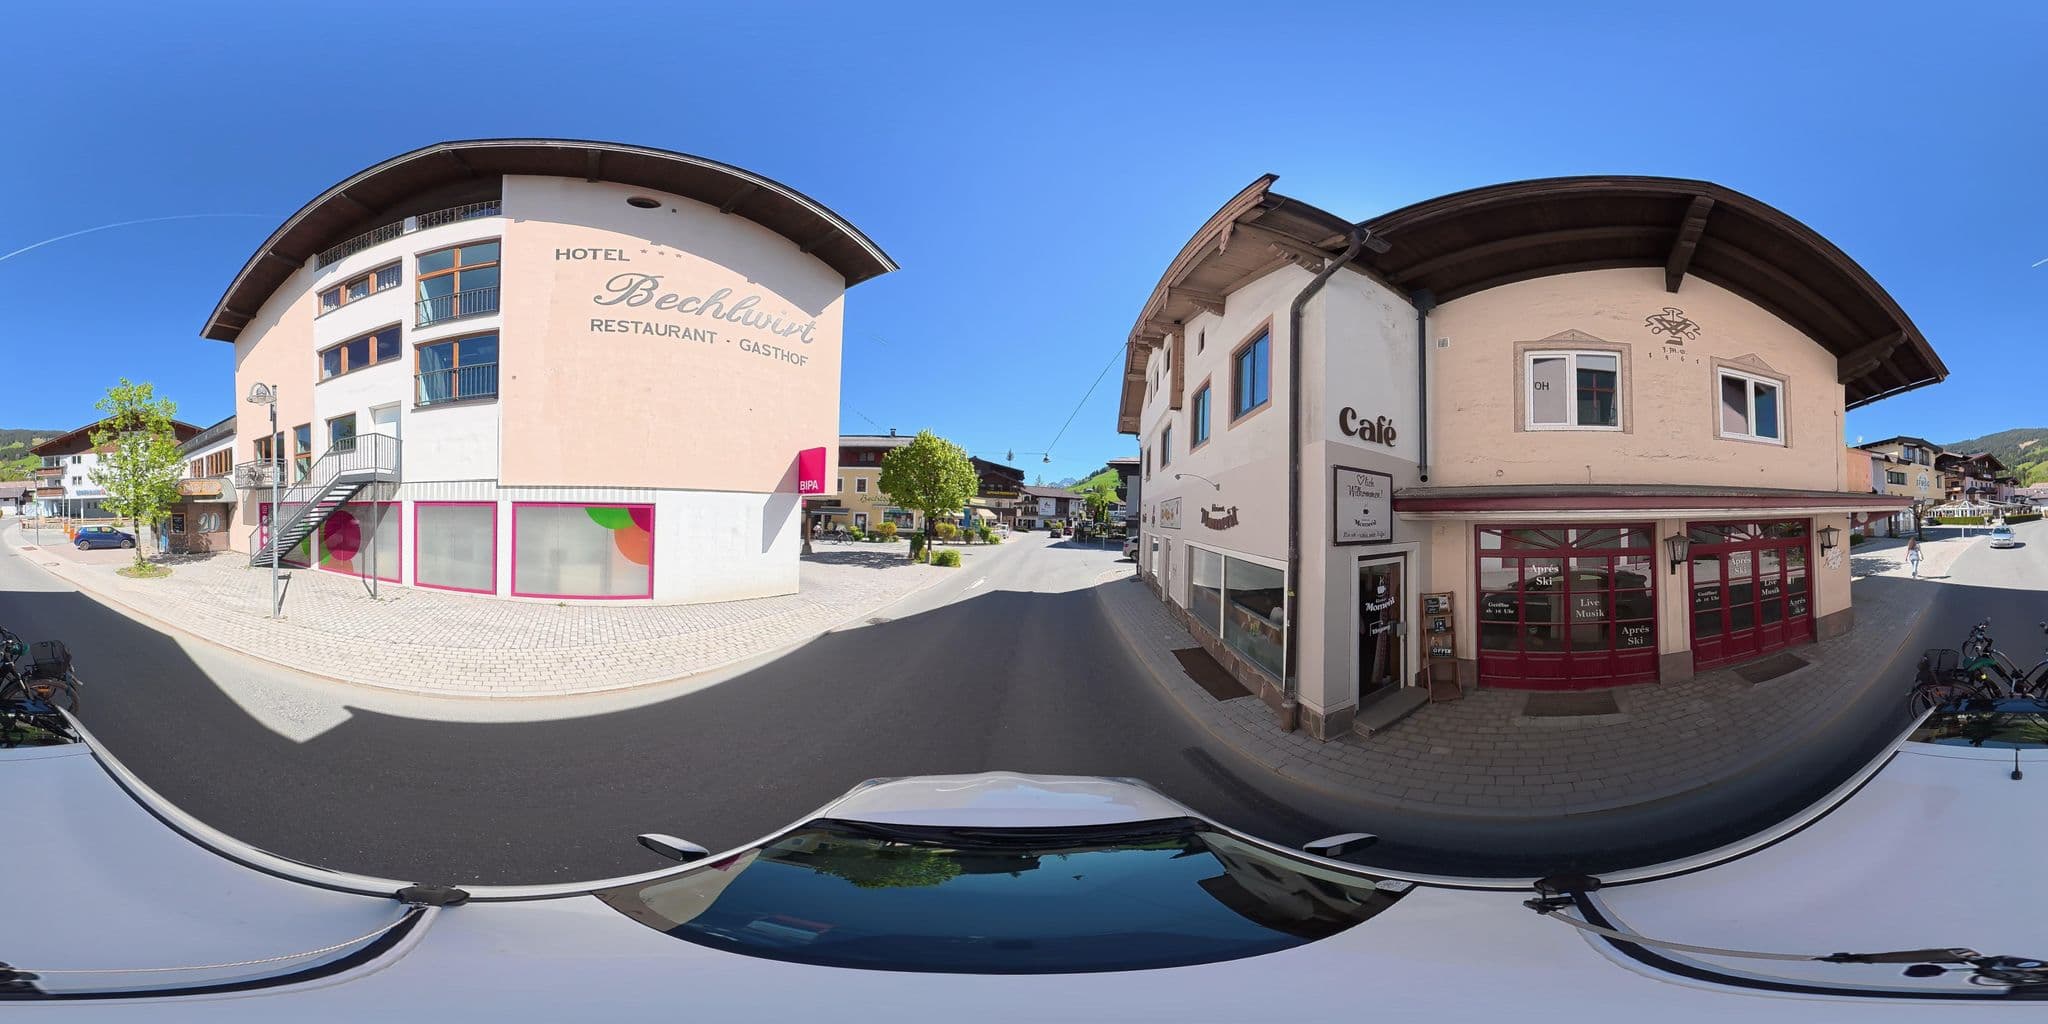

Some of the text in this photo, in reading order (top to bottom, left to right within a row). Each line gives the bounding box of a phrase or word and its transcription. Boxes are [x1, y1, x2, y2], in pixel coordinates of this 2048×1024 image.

[555, 248, 631, 262] HOTEL
[593, 272, 816, 344] Bechlwirt
[590, 318, 809, 367] RESTAURANT GASTHOF
[1339, 406, 1397, 448] Café
[799, 480, 819, 490] BIPA
[1734, 567, 1747, 576] Ski
[1536, 576, 1553, 586] Ski
[1764, 578, 1778, 587] Live
[1761, 587, 1780, 596] Musik
[1580, 599, 1600, 607] Live
[1576, 608, 1605, 618] Musik
[1627, 636, 1644, 645] Ski
